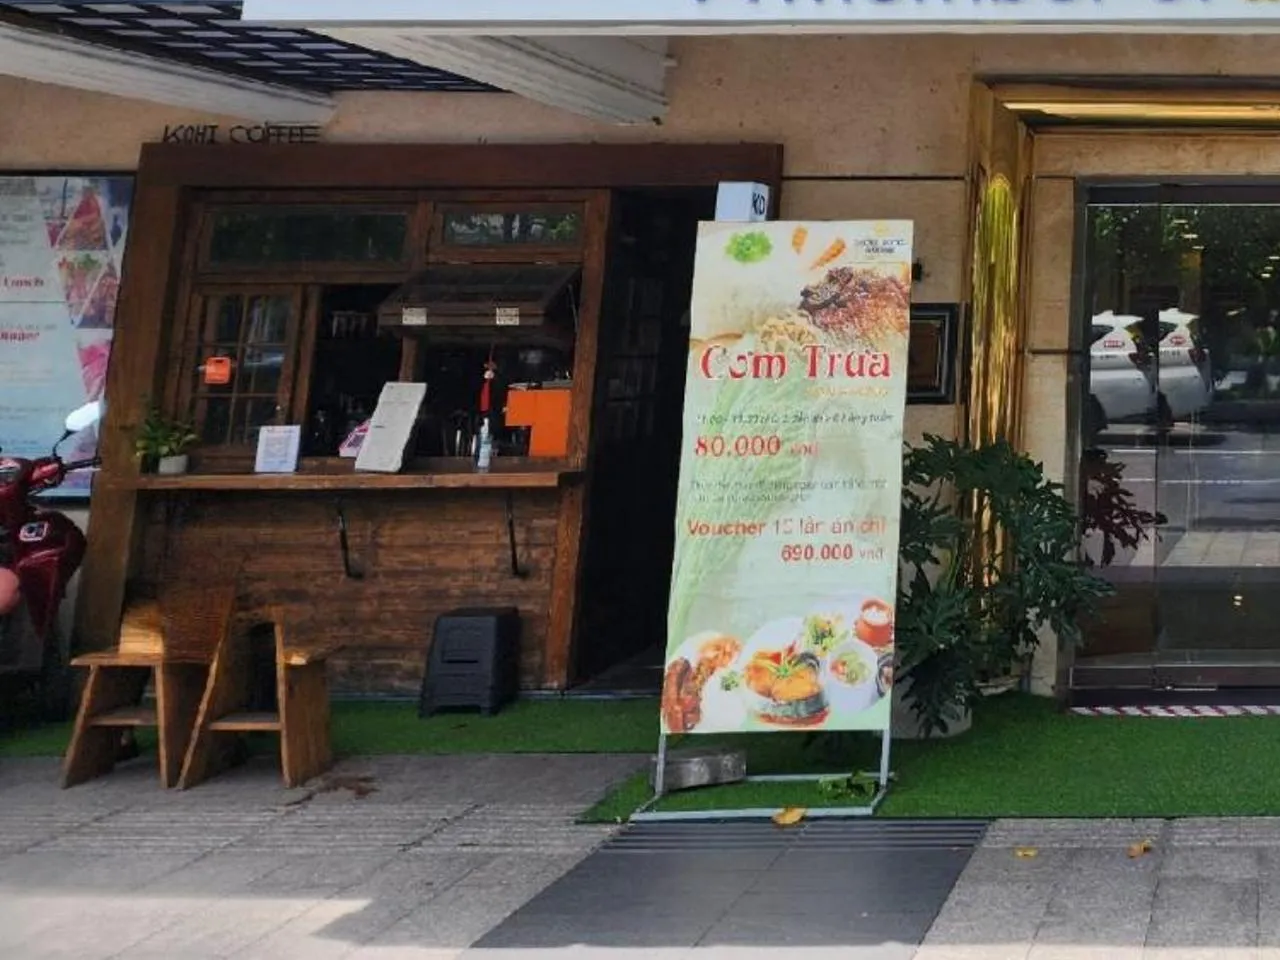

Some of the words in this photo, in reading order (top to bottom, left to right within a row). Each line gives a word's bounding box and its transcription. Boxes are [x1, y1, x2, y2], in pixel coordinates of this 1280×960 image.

[162, 124, 219, 144] KOHI
[229, 121, 322, 144] COFFEE
[687, 519, 766, 536] Voucher
